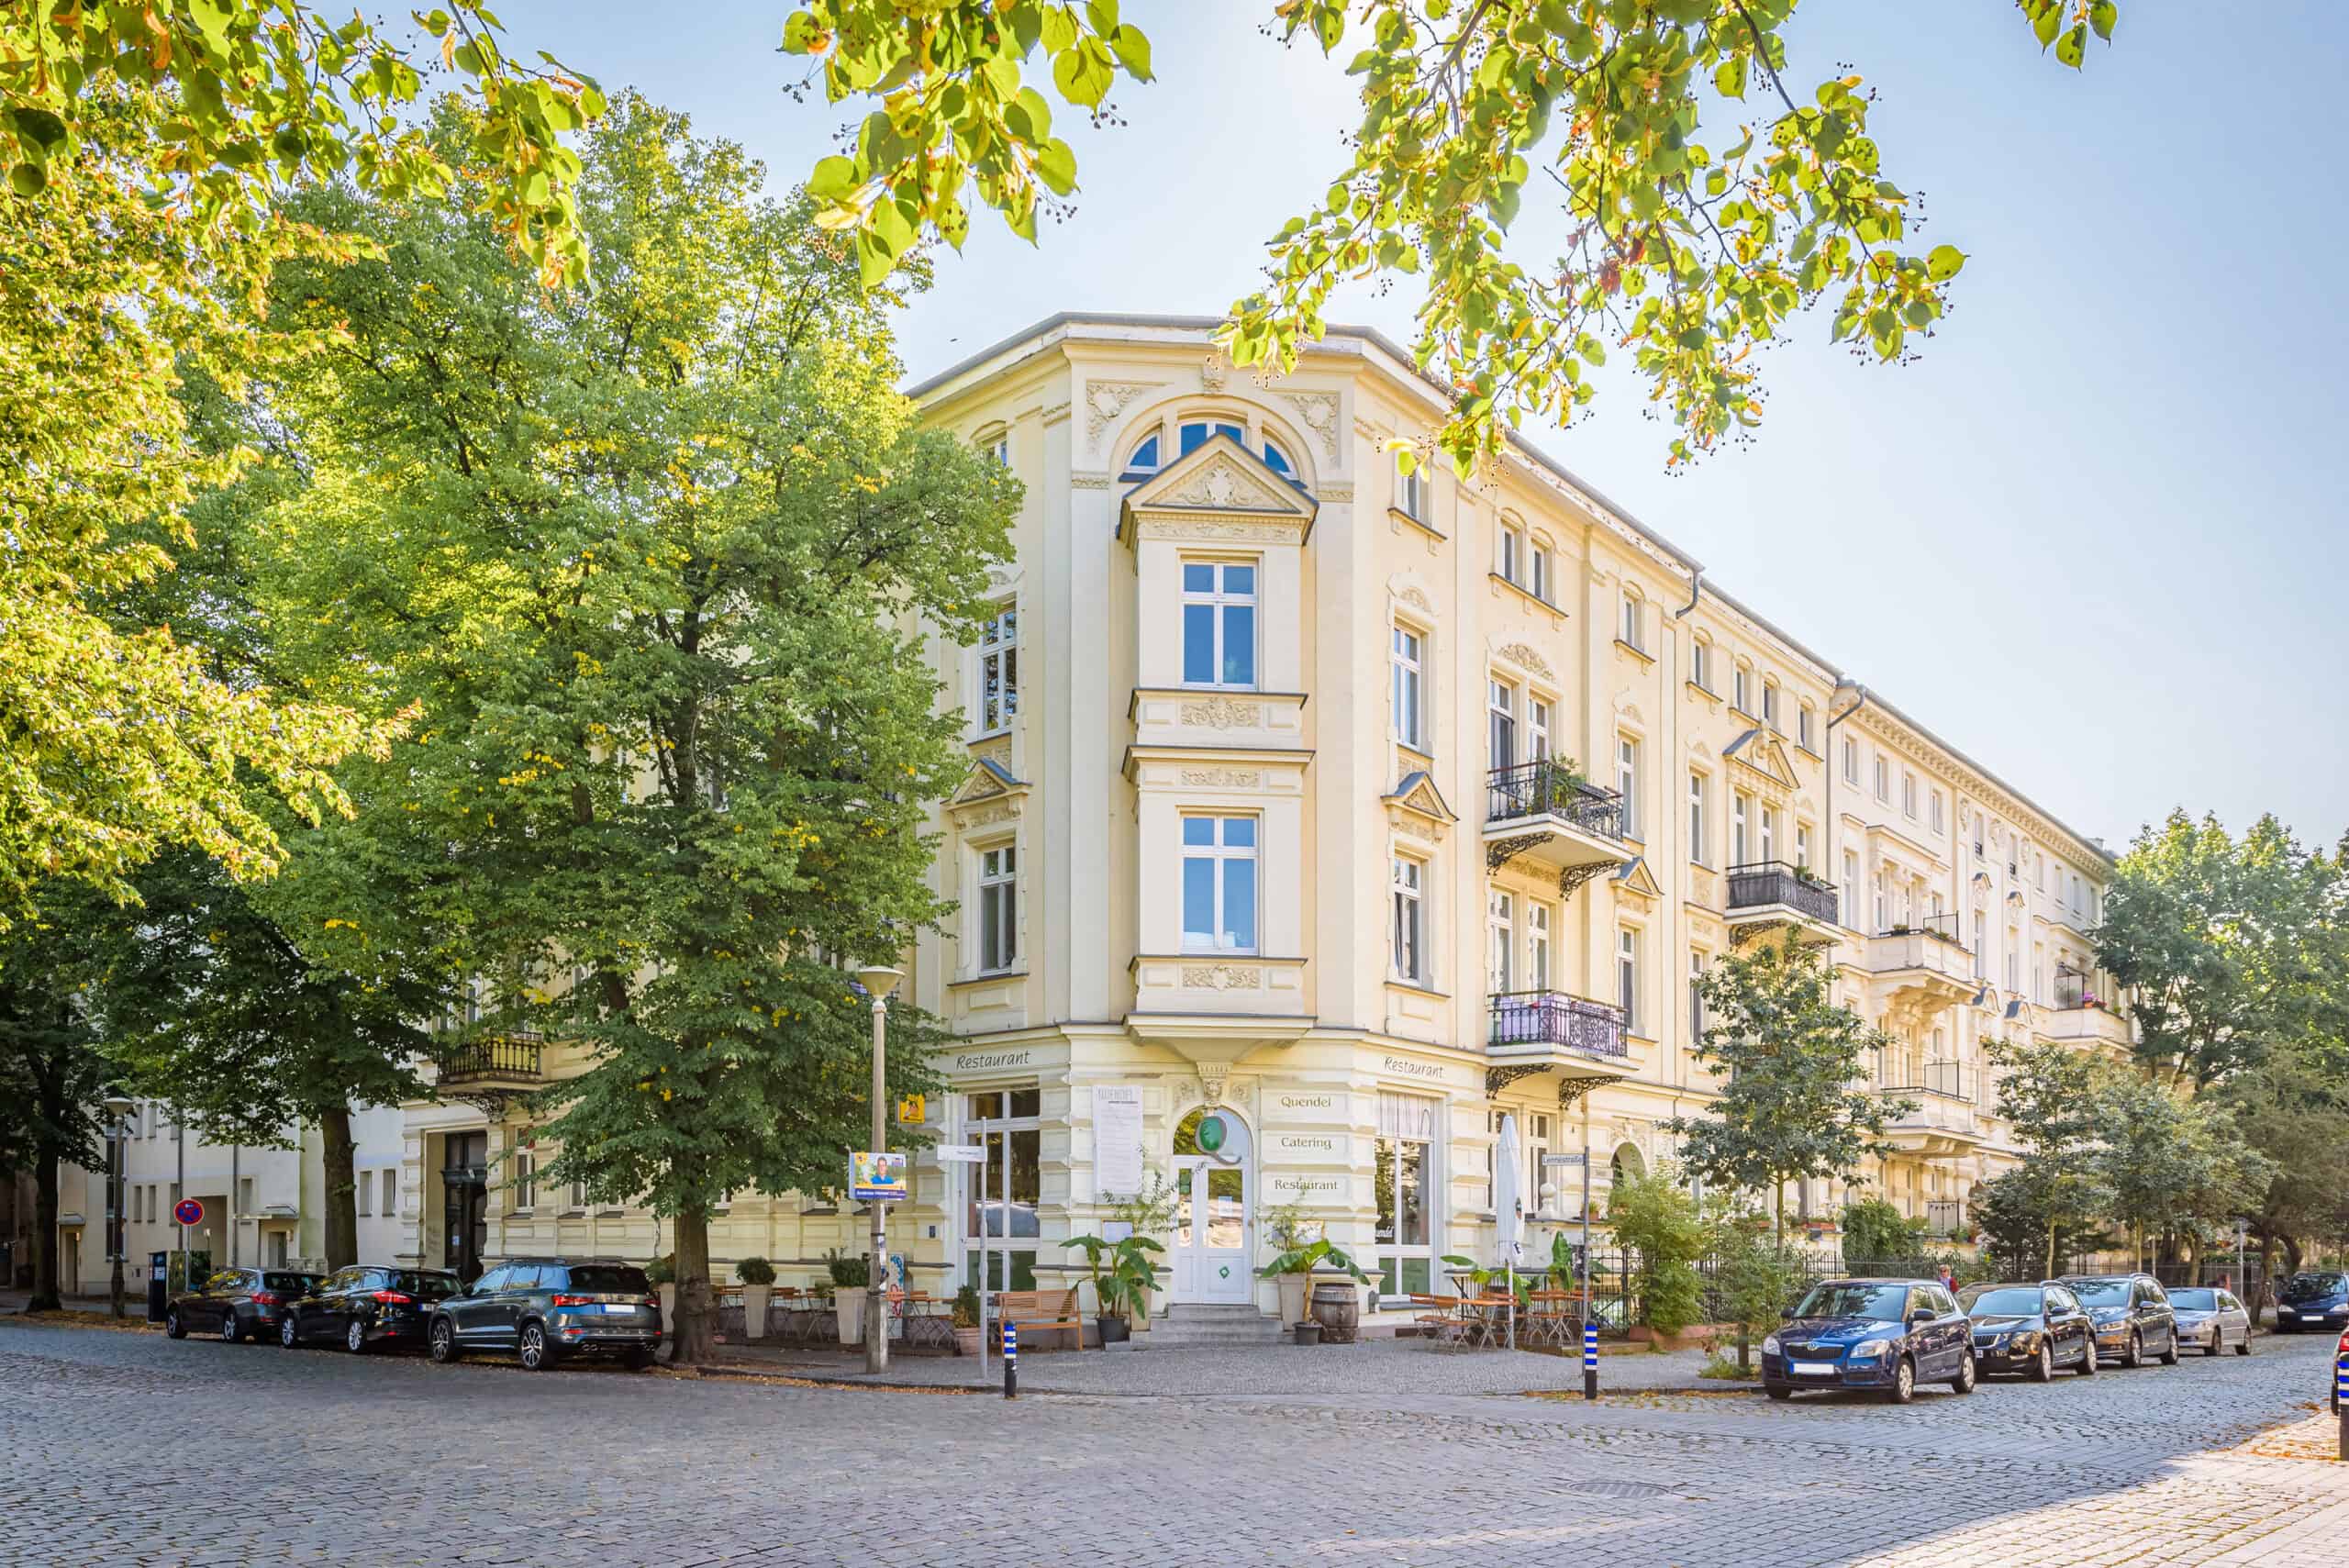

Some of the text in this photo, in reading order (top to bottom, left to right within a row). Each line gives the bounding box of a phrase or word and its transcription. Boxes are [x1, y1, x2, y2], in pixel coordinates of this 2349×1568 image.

[956, 1050, 1030, 1070] Restaurant
[1385, 1056, 1443, 1079] Restaurant
[1281, 1095, 1331, 1108] Quendel
[1281, 1137, 1332, 1151] Catering
[1275, 1179, 1338, 1190] Restaurant
